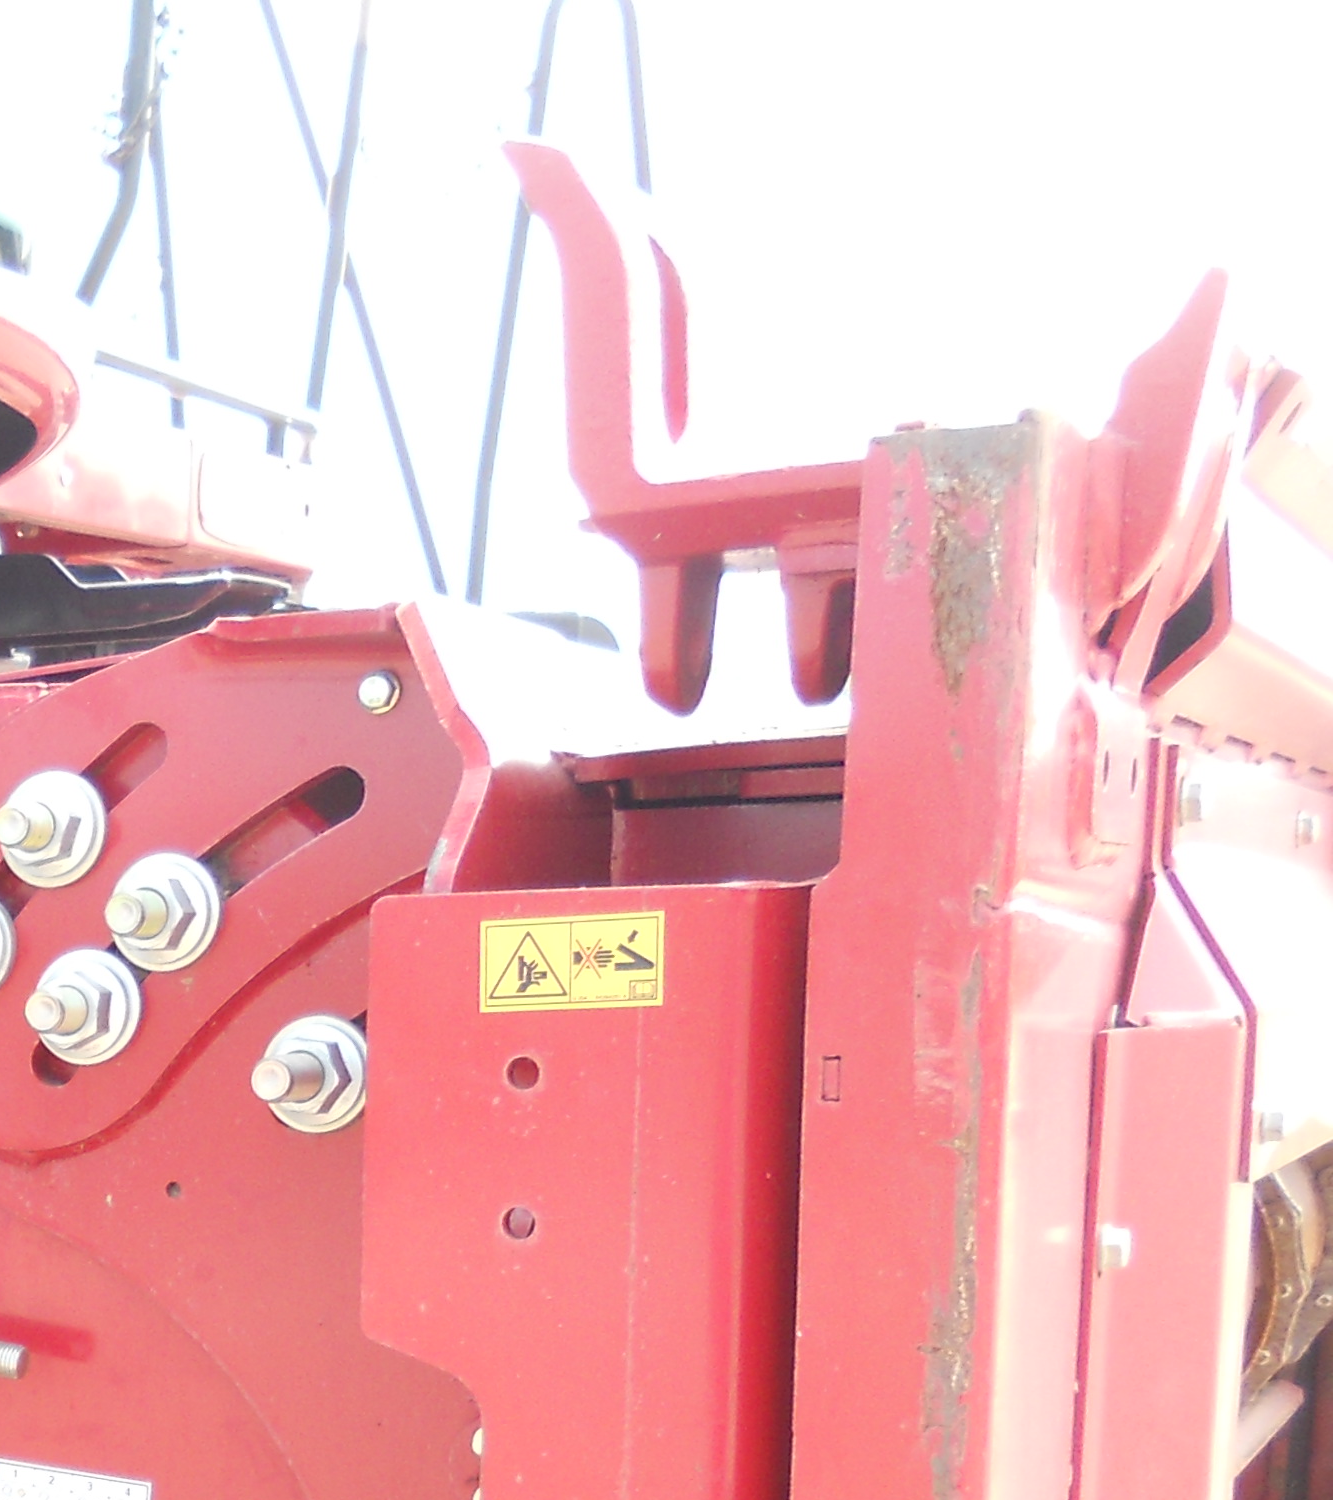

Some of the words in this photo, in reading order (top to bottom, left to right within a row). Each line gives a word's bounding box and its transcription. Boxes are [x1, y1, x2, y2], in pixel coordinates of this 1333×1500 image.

[49, 1476, 55, 1485] 2
[87, 1482, 93, 1491] 3
[125, 1487, 131, 1496] 4
